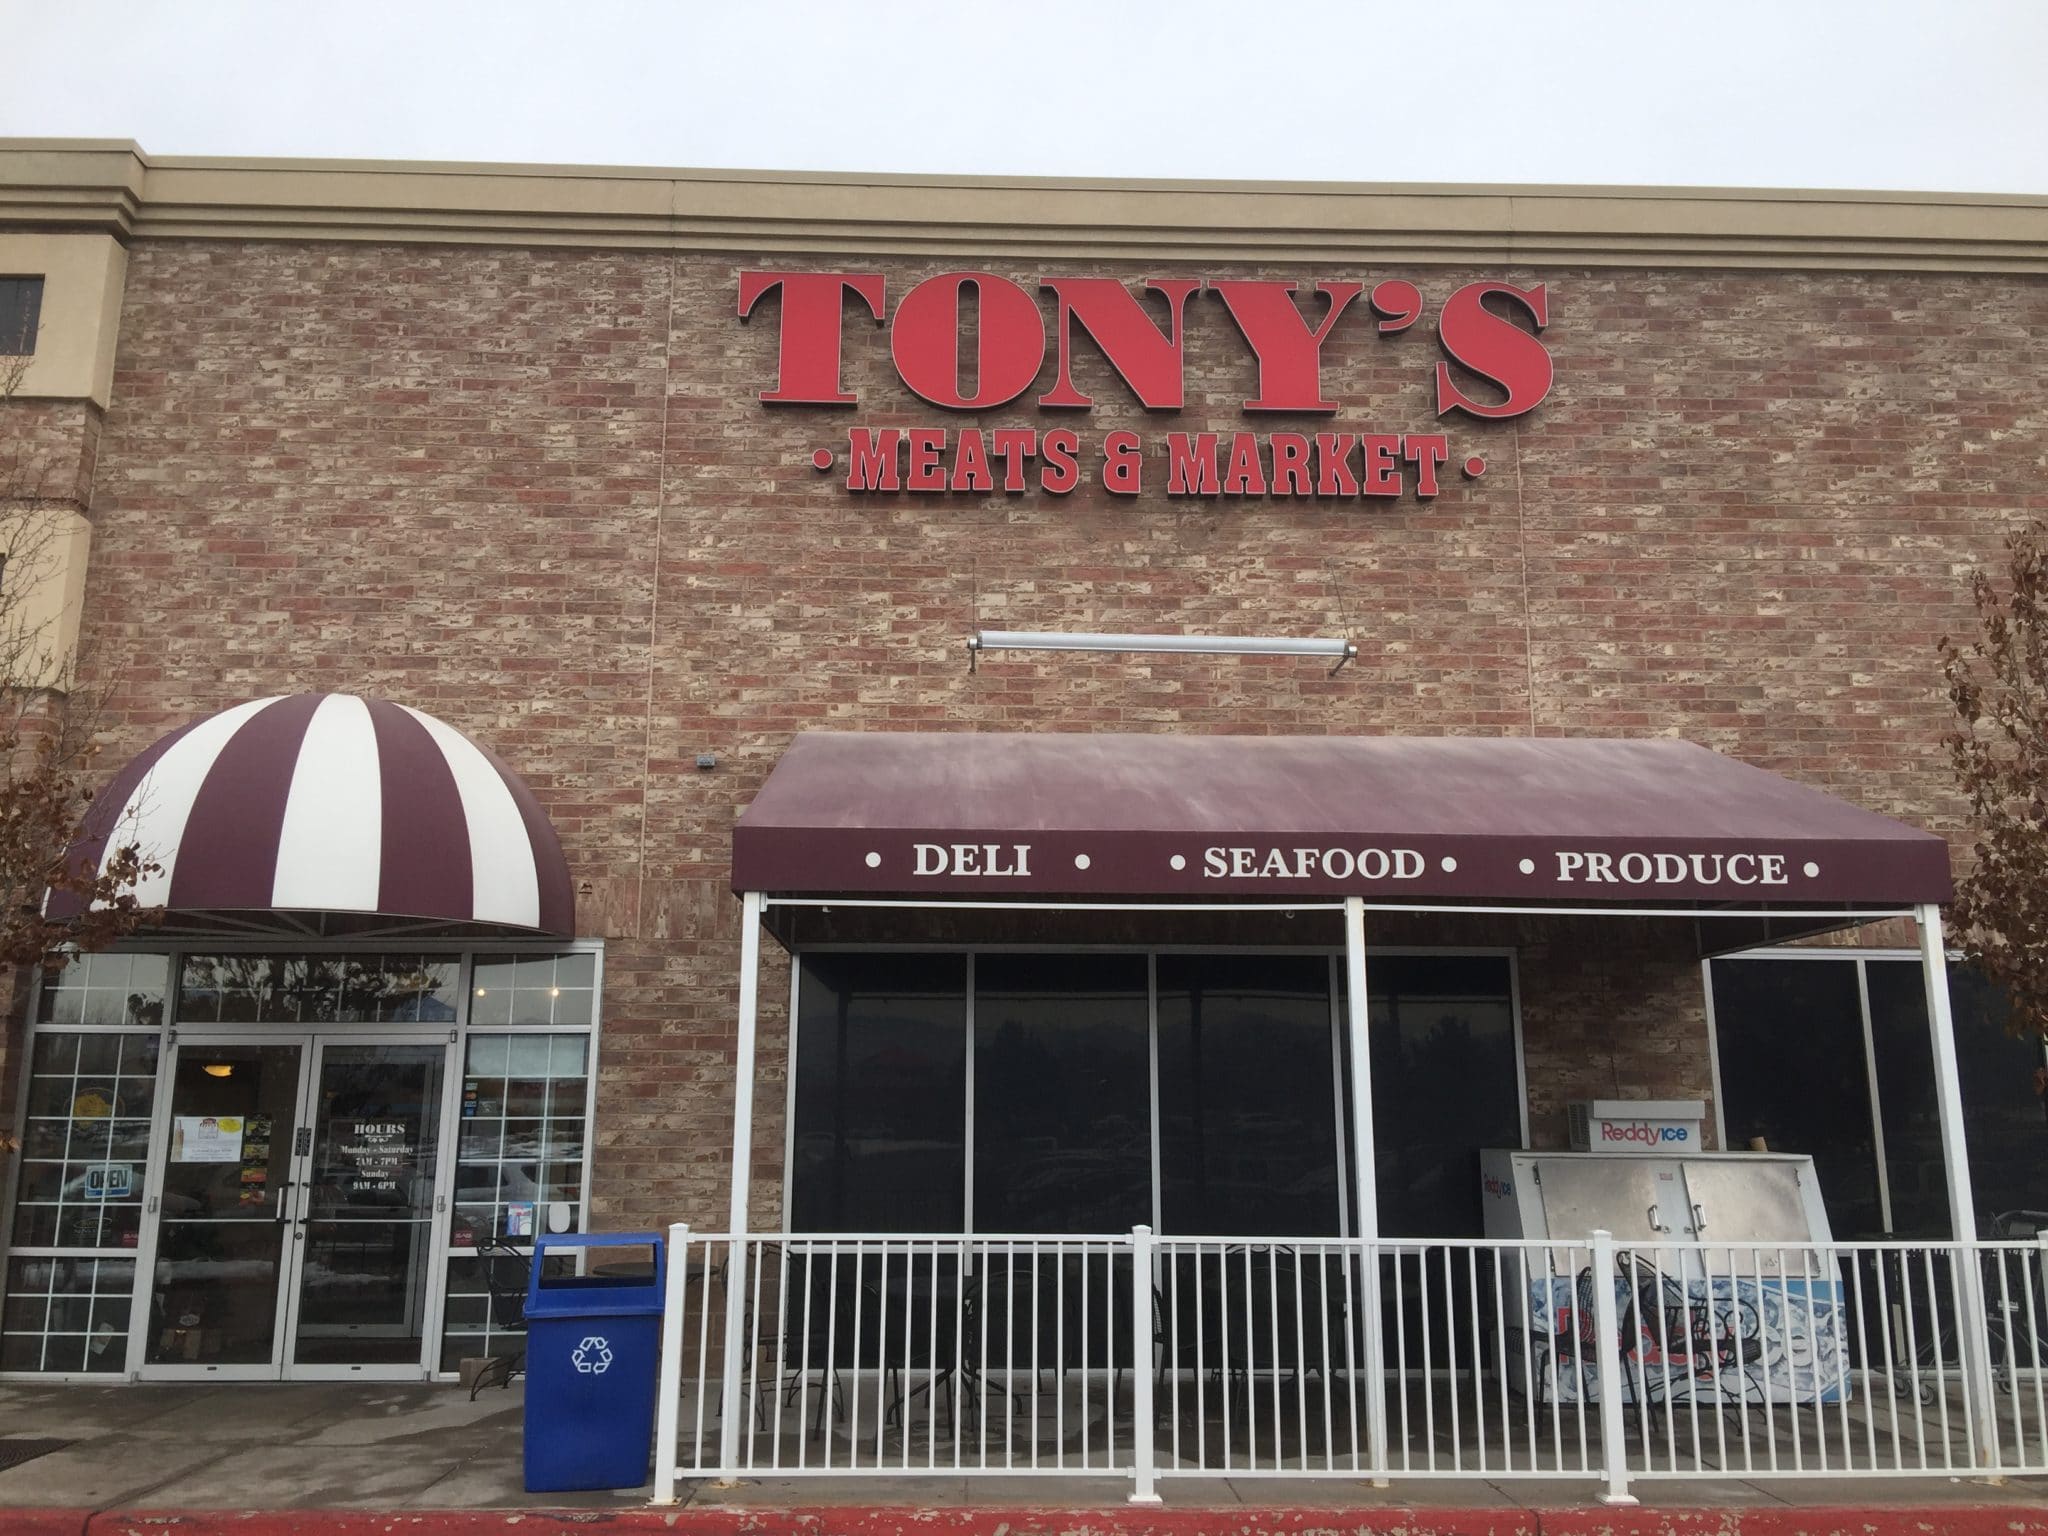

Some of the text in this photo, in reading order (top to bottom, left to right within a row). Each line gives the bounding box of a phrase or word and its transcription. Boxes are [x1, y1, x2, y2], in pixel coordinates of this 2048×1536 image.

[737, 271, 1554, 418] TONY'S
[846, 427, 1448, 499] MEATS & MARKET
[912, 844, 1789, 885] DELI SEAFOOD PRODUCE
[354, 1124, 406, 1134] HOURS
[379, 1145, 413, 1155] Saturday
[90, 1170, 129, 1188] OPEN
[361, 1170, 389, 1179] Sunday
